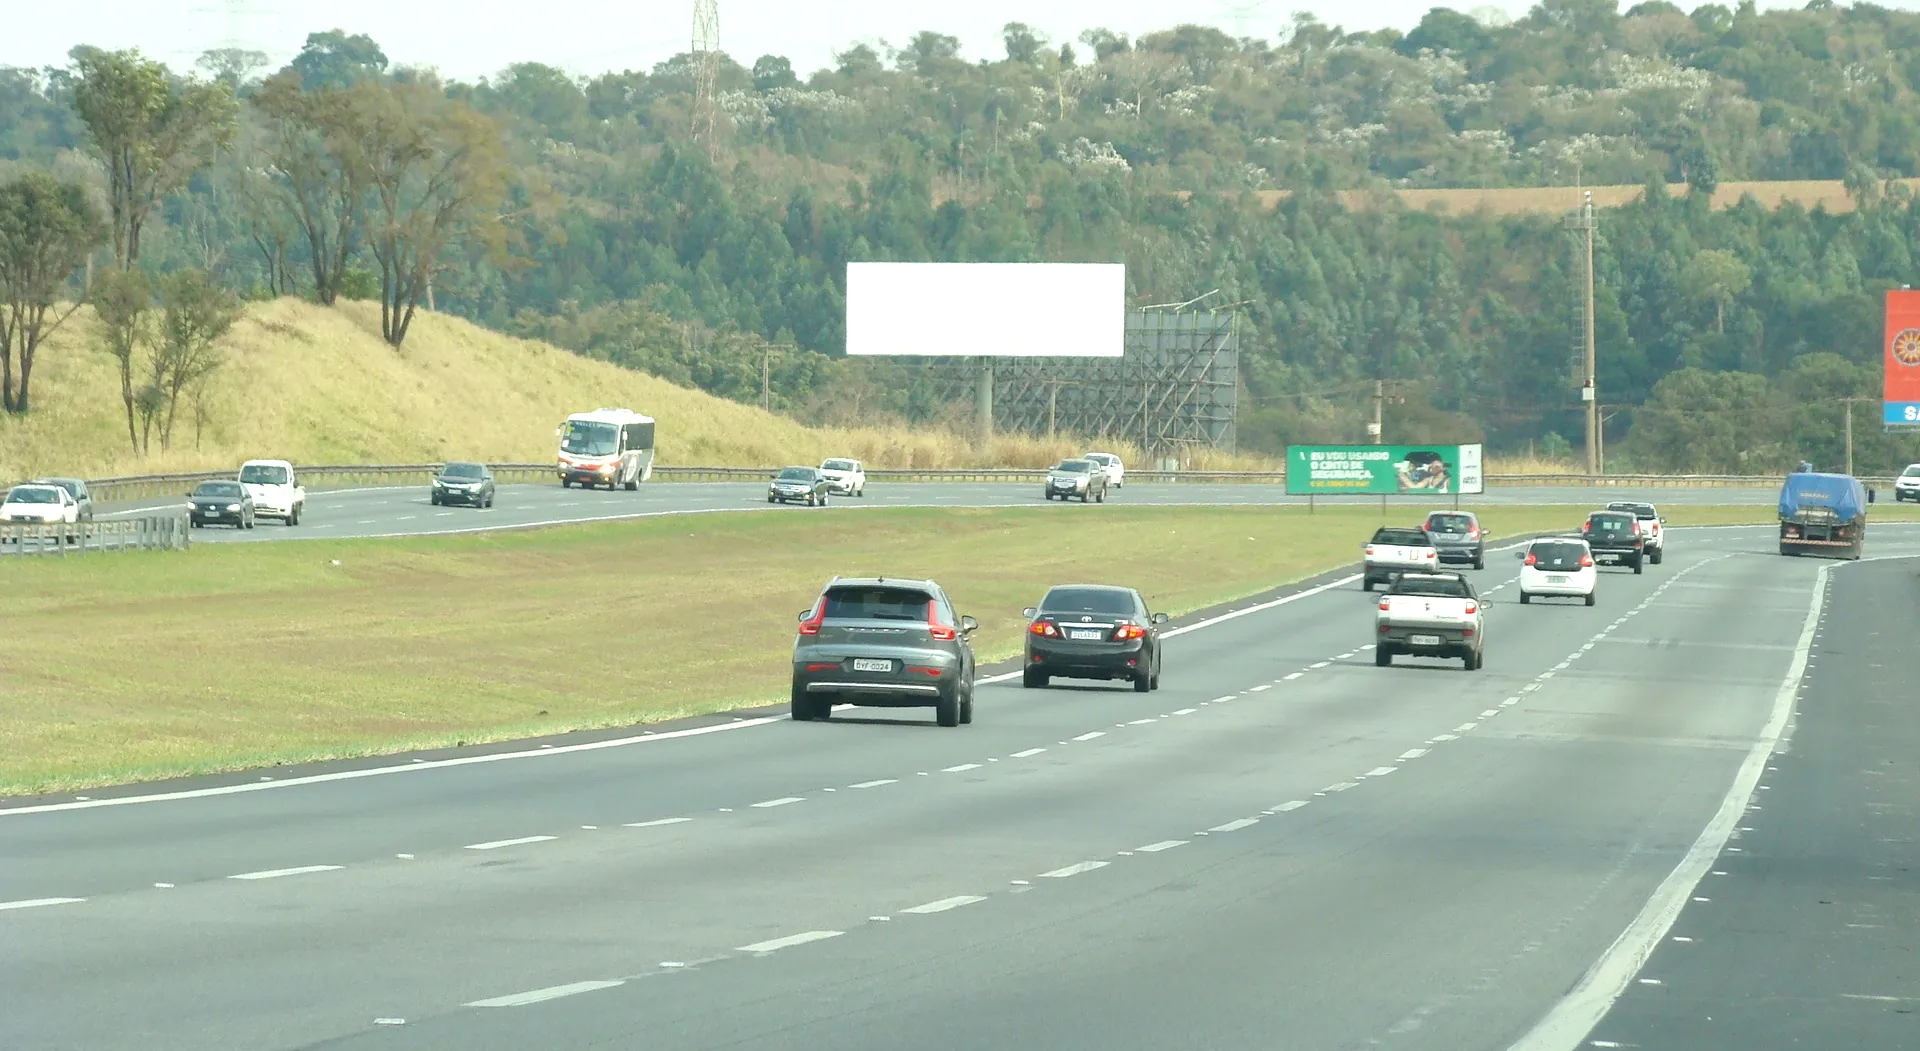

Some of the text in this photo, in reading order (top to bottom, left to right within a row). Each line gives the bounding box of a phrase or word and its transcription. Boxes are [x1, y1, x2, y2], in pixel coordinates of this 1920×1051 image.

[1310, 451, 1390, 461] EU VOU USANDO
[1319, 460, 1349, 470] CINTO
[1350, 460, 1365, 470] DE
